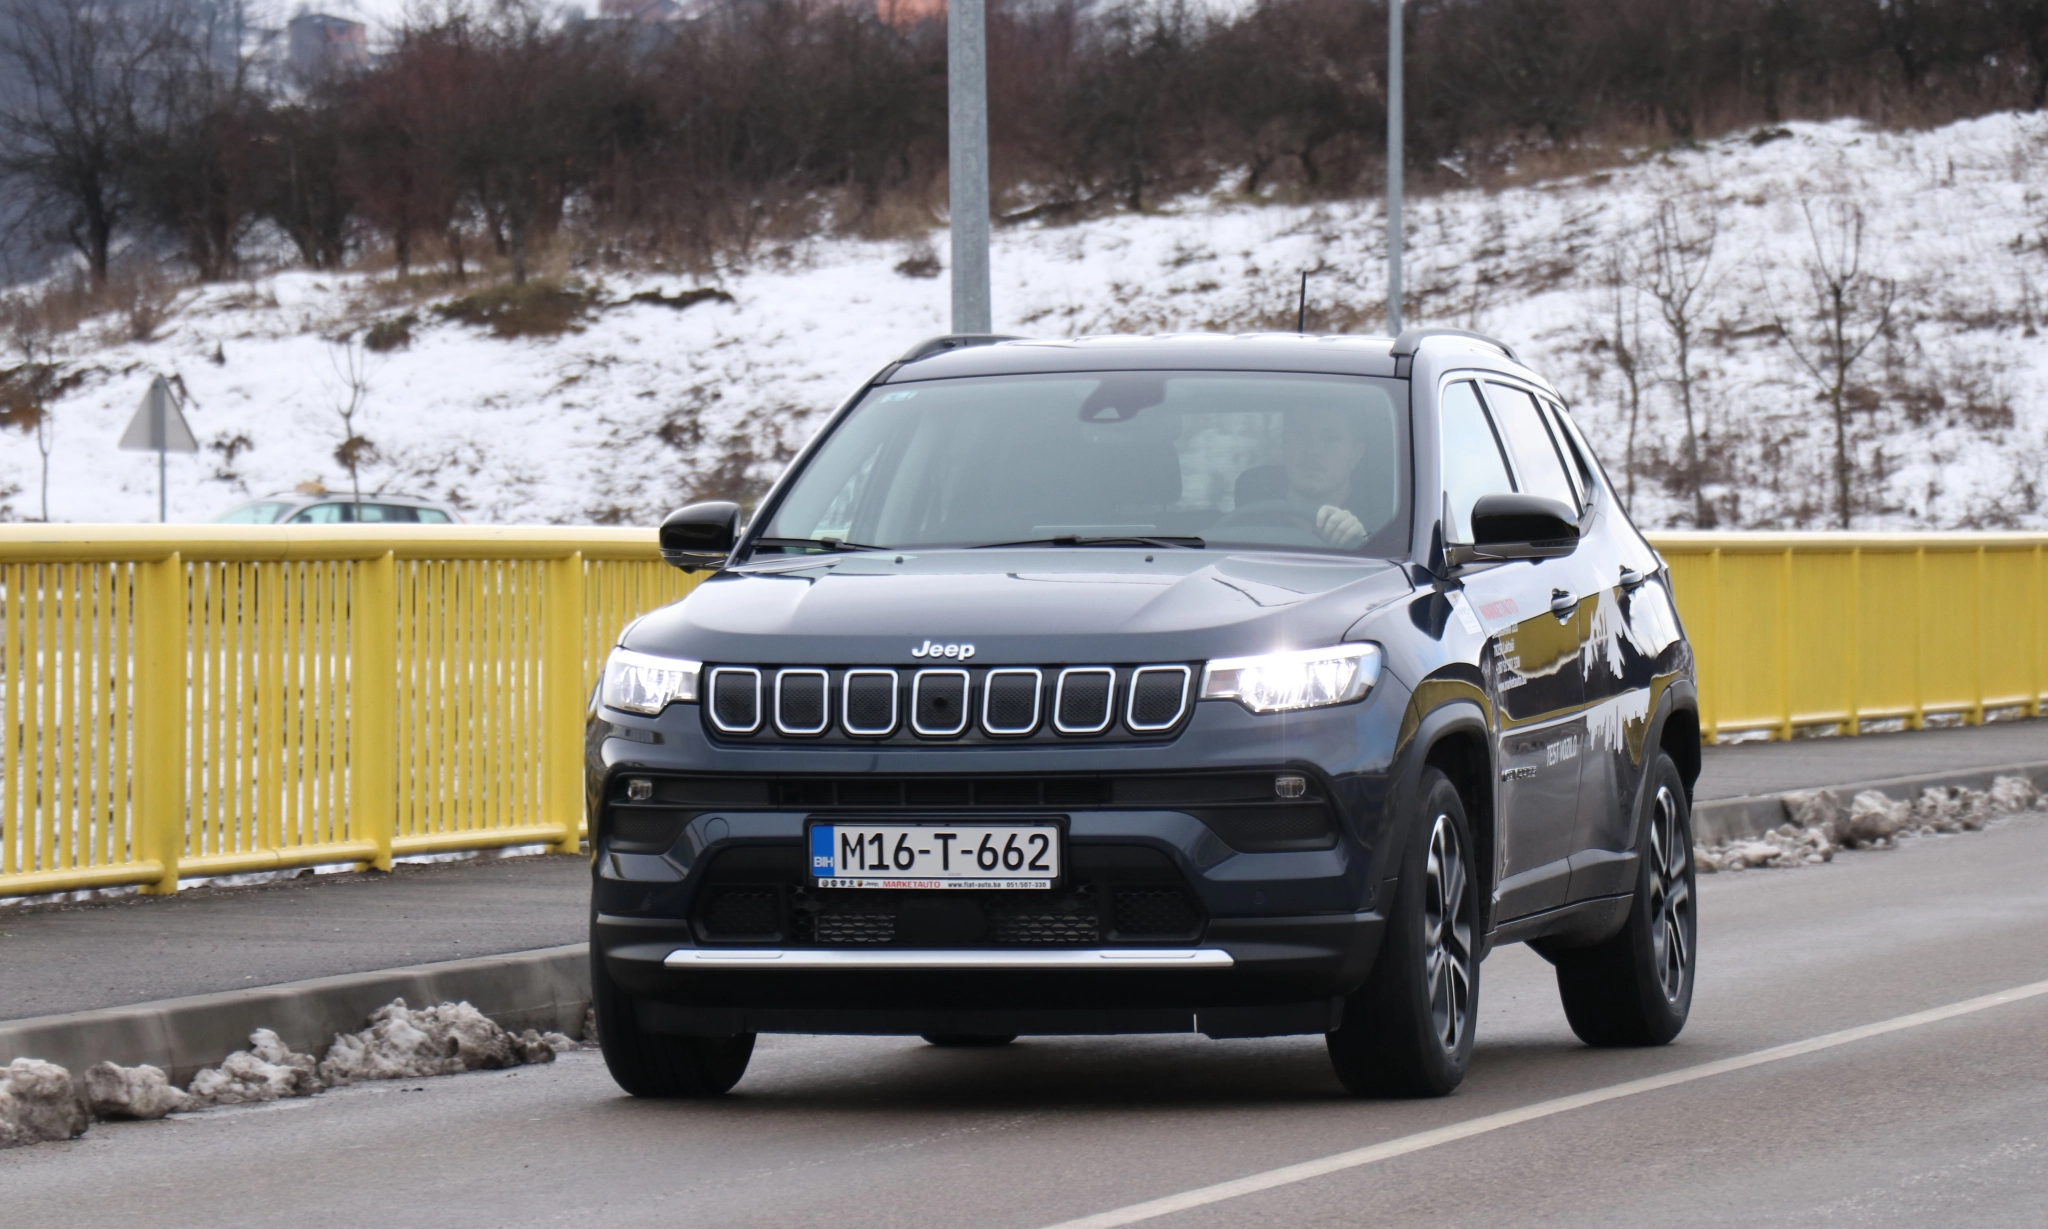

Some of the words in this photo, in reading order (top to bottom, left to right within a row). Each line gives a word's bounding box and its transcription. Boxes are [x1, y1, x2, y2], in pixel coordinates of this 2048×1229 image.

[911, 640, 976, 662] Jeep
[1546, 741, 1560, 768] TEST
[813, 856, 834, 868] BIH
[841, 832, 1050, 871] M16-T-662
[883, 880, 941, 888] MARKETAUTO
